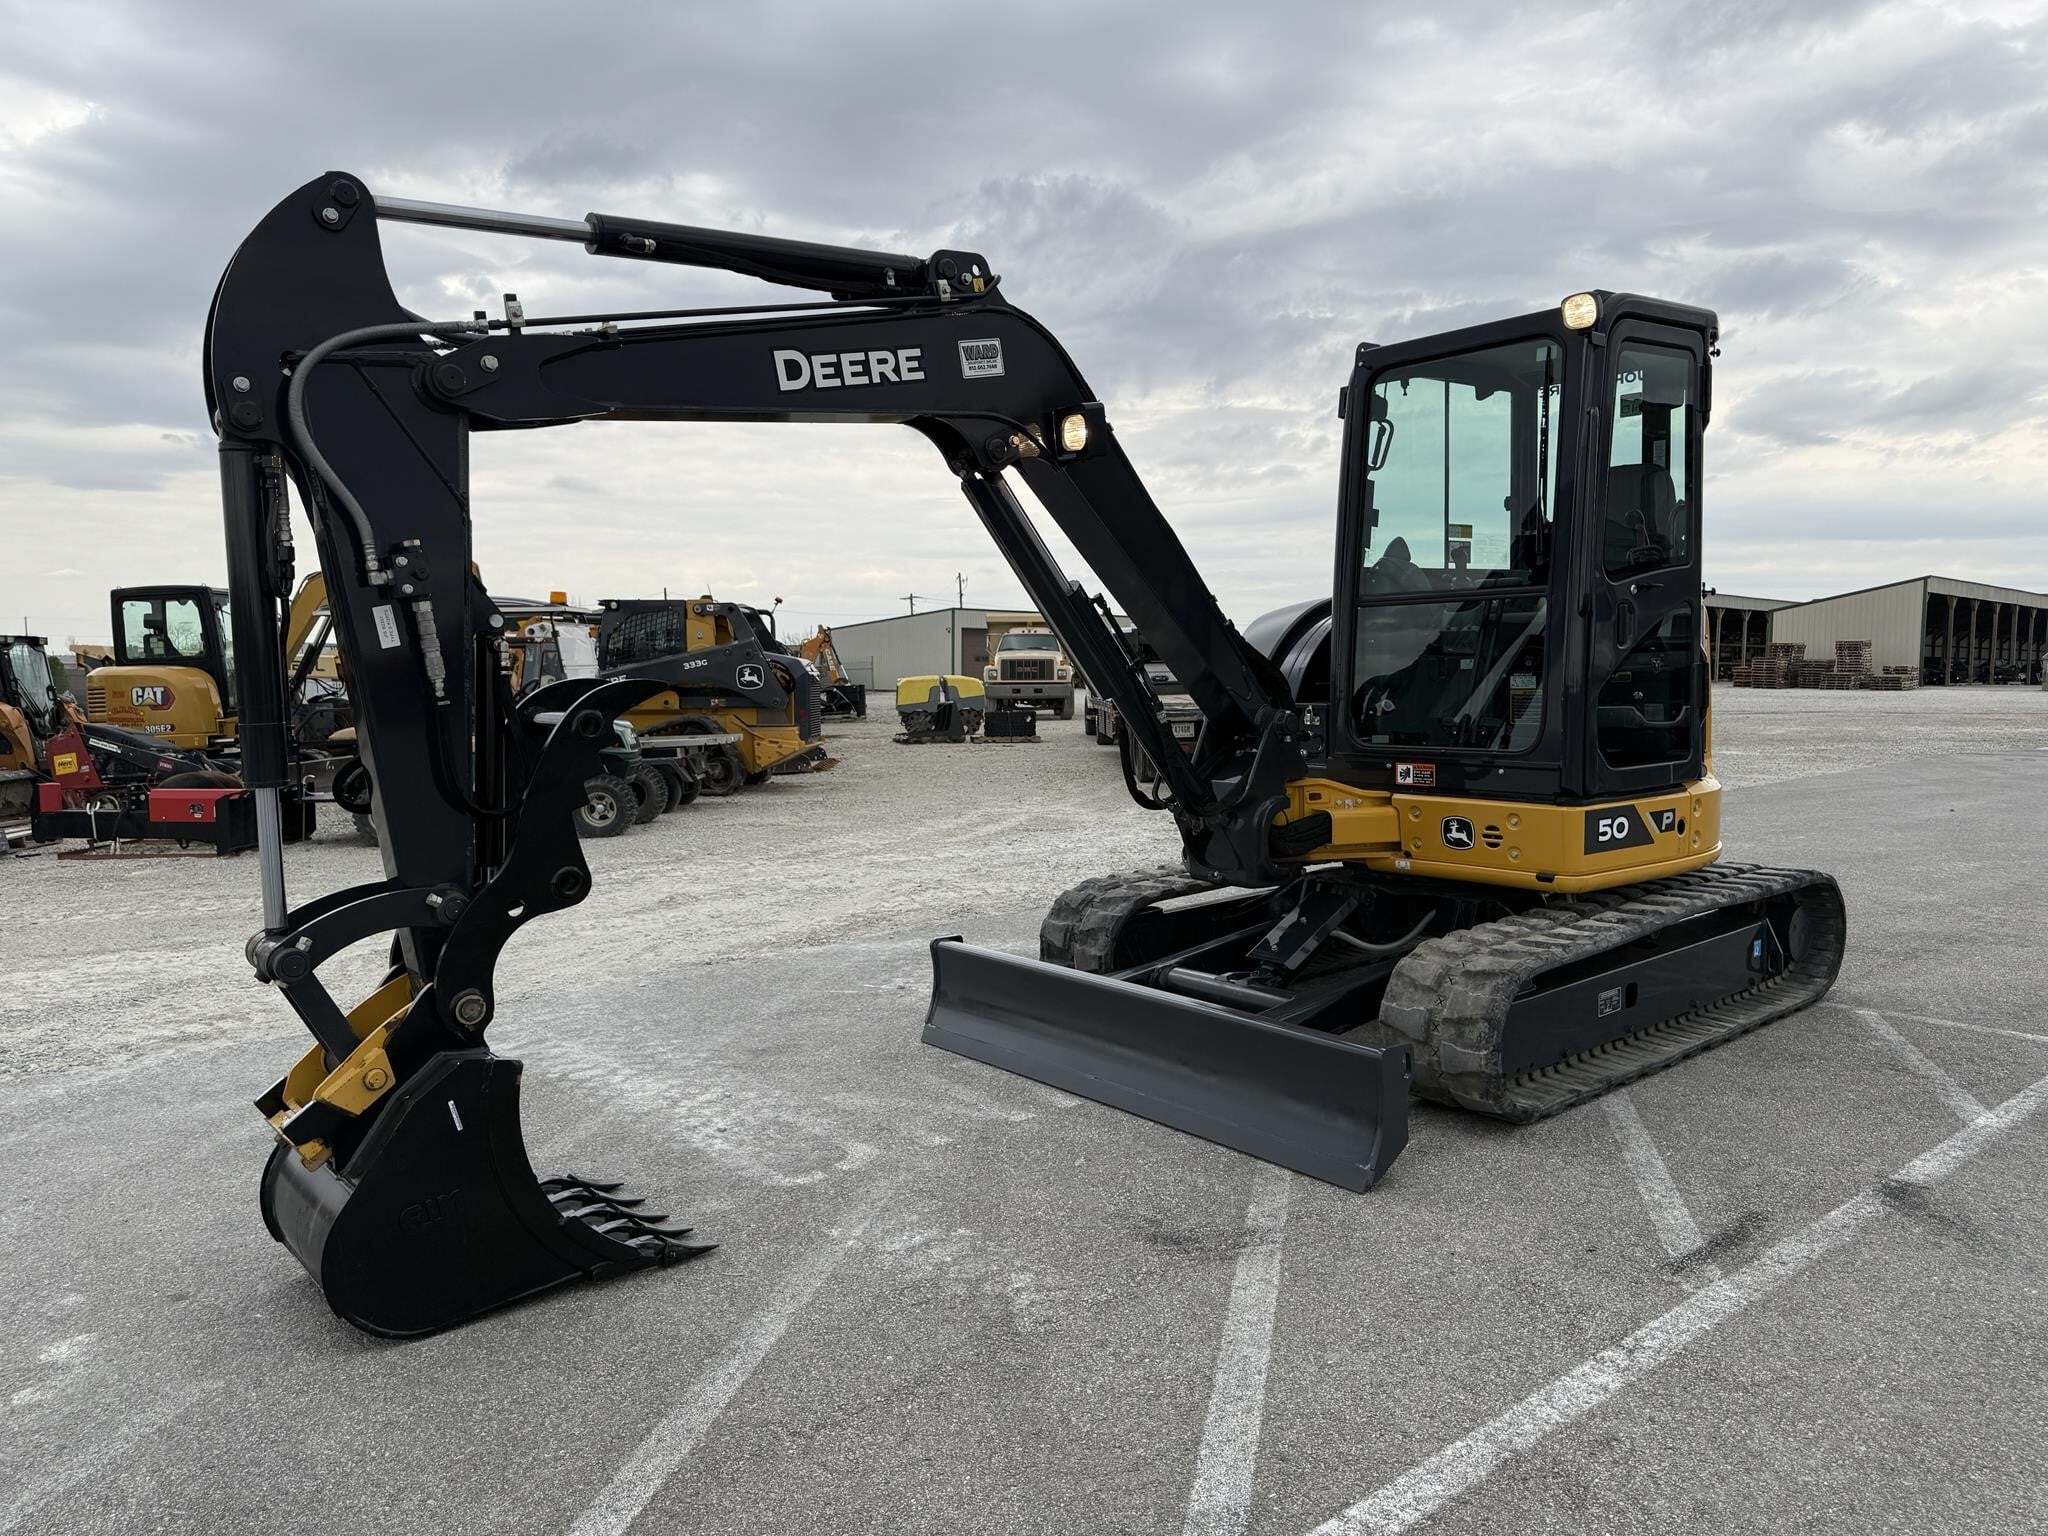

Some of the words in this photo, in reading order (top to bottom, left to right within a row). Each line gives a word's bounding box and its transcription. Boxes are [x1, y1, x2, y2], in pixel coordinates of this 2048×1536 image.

[962, 343, 999, 361] WARD
[773, 348, 925, 391] DEERE
[683, 659, 708, 670] 333G
[131, 686, 164, 706] CAT
[145, 724, 171, 734] 305E2
[1598, 816, 1629, 842] 50
[1662, 812, 1674, 830] P
